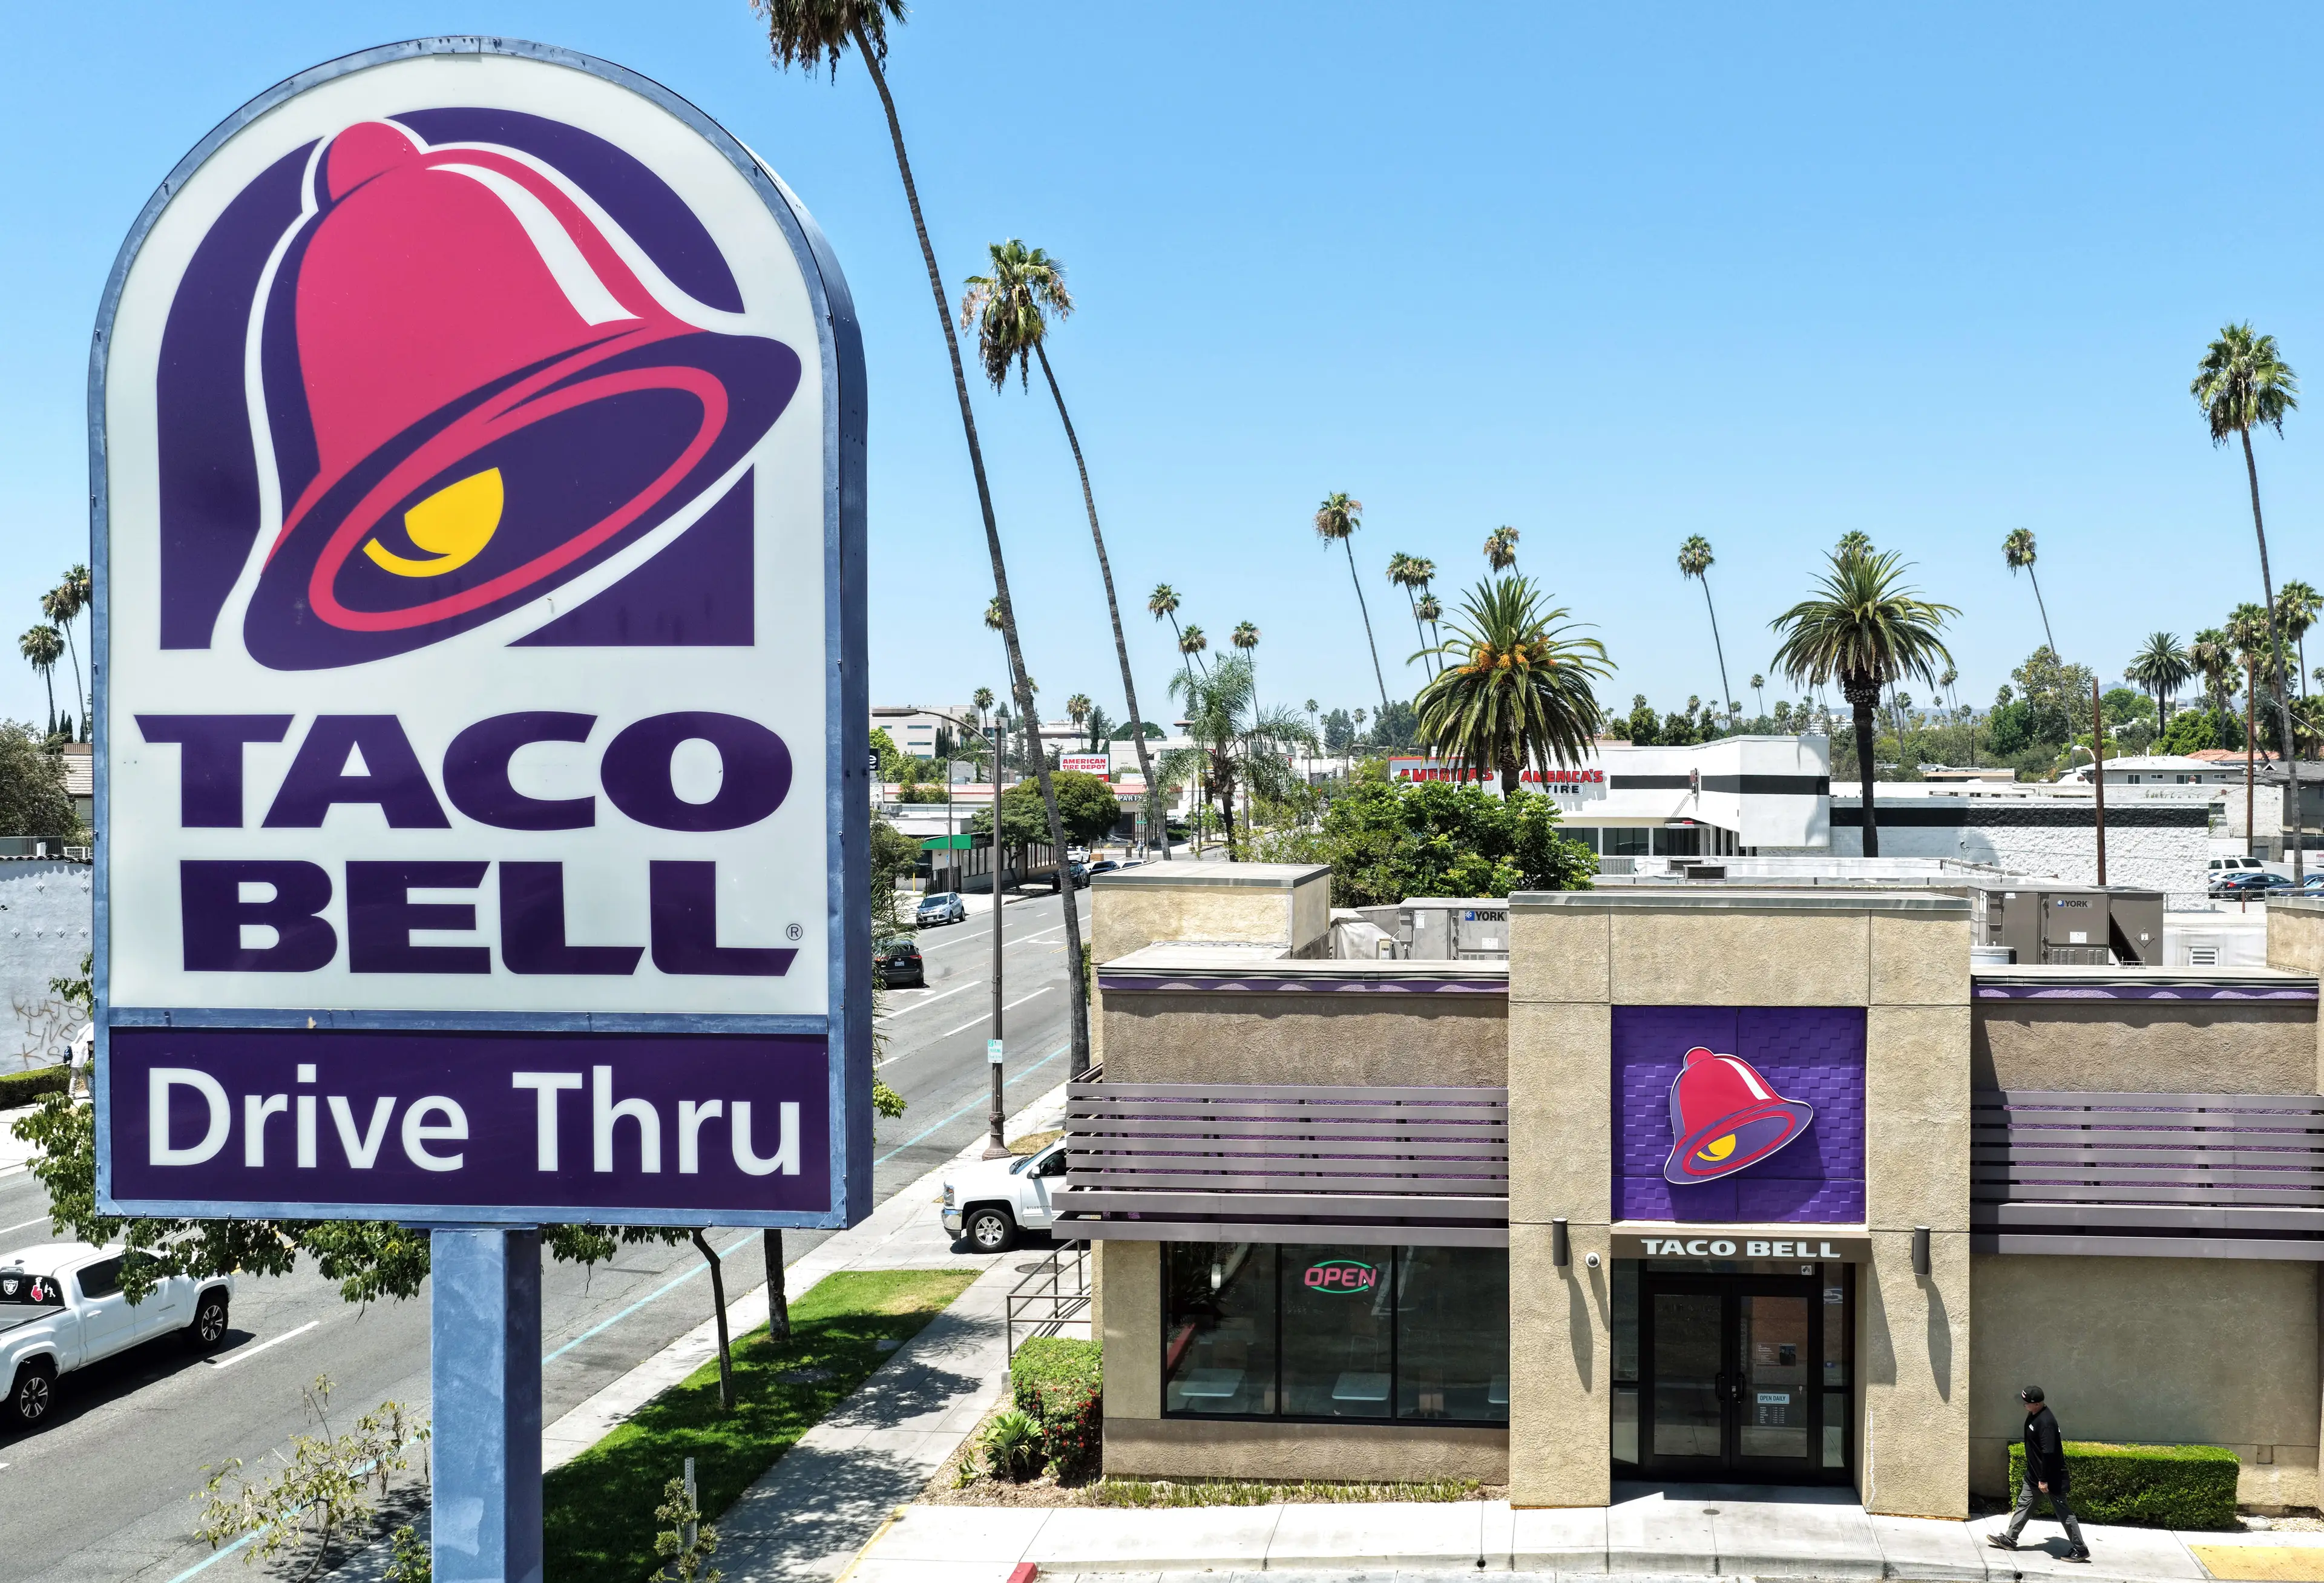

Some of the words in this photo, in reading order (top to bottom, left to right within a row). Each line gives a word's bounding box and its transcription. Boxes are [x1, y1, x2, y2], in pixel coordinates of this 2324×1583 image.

[134, 711, 793, 832] TACO
[1520, 769, 1603, 783] AMERICA'S
[1546, 785, 1580, 794] TIRE
[180, 860, 799, 976] BELL
[1475, 911, 1505, 921] YORK
[149, 1064, 469, 1172] Drive
[512, 1065, 800, 1176] Thru
[1641, 1239, 1736, 1256] TACO
[1747, 1241, 1841, 1258] BELL
[1304, 1268, 1377, 1286] OPEN
